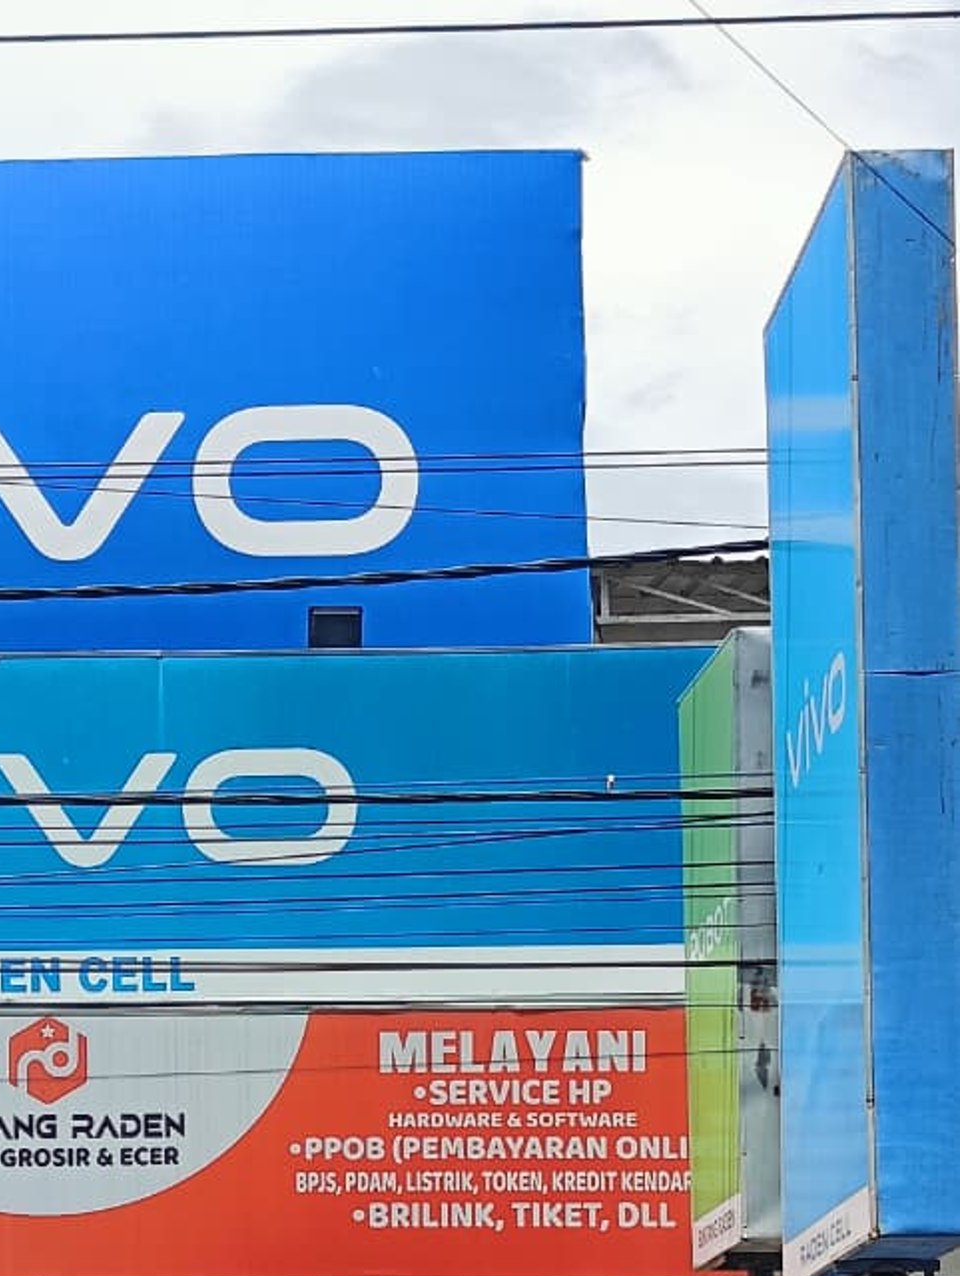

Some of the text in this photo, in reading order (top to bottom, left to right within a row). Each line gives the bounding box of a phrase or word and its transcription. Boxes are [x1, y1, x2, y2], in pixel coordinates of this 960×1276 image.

[786, 650, 846, 789] vivo
[79, 956, 195, 992] CELL
[379, 1030, 647, 1073] MELAYANI
[428, 1079, 612, 1105] SERVICE HP
[71, 1113, 186, 1139] RADEN
[388, 1112, 638, 1128] HARDWARE & SOFTWARE
[0, 1148, 90, 1167] GROSIR
[96, 1148, 113, 1166] &
[120, 1147, 179, 1166] ECER
[305, 1136, 689, 1164] PPOB (PEMBAYARAN ONLI
[296, 1172, 693, 1194] BPJS, PDAM, LISTRIK, TOKEN, KREDIT KENDAR
[369, 1203, 676, 1231] BRILINK, TIKET, DLL
